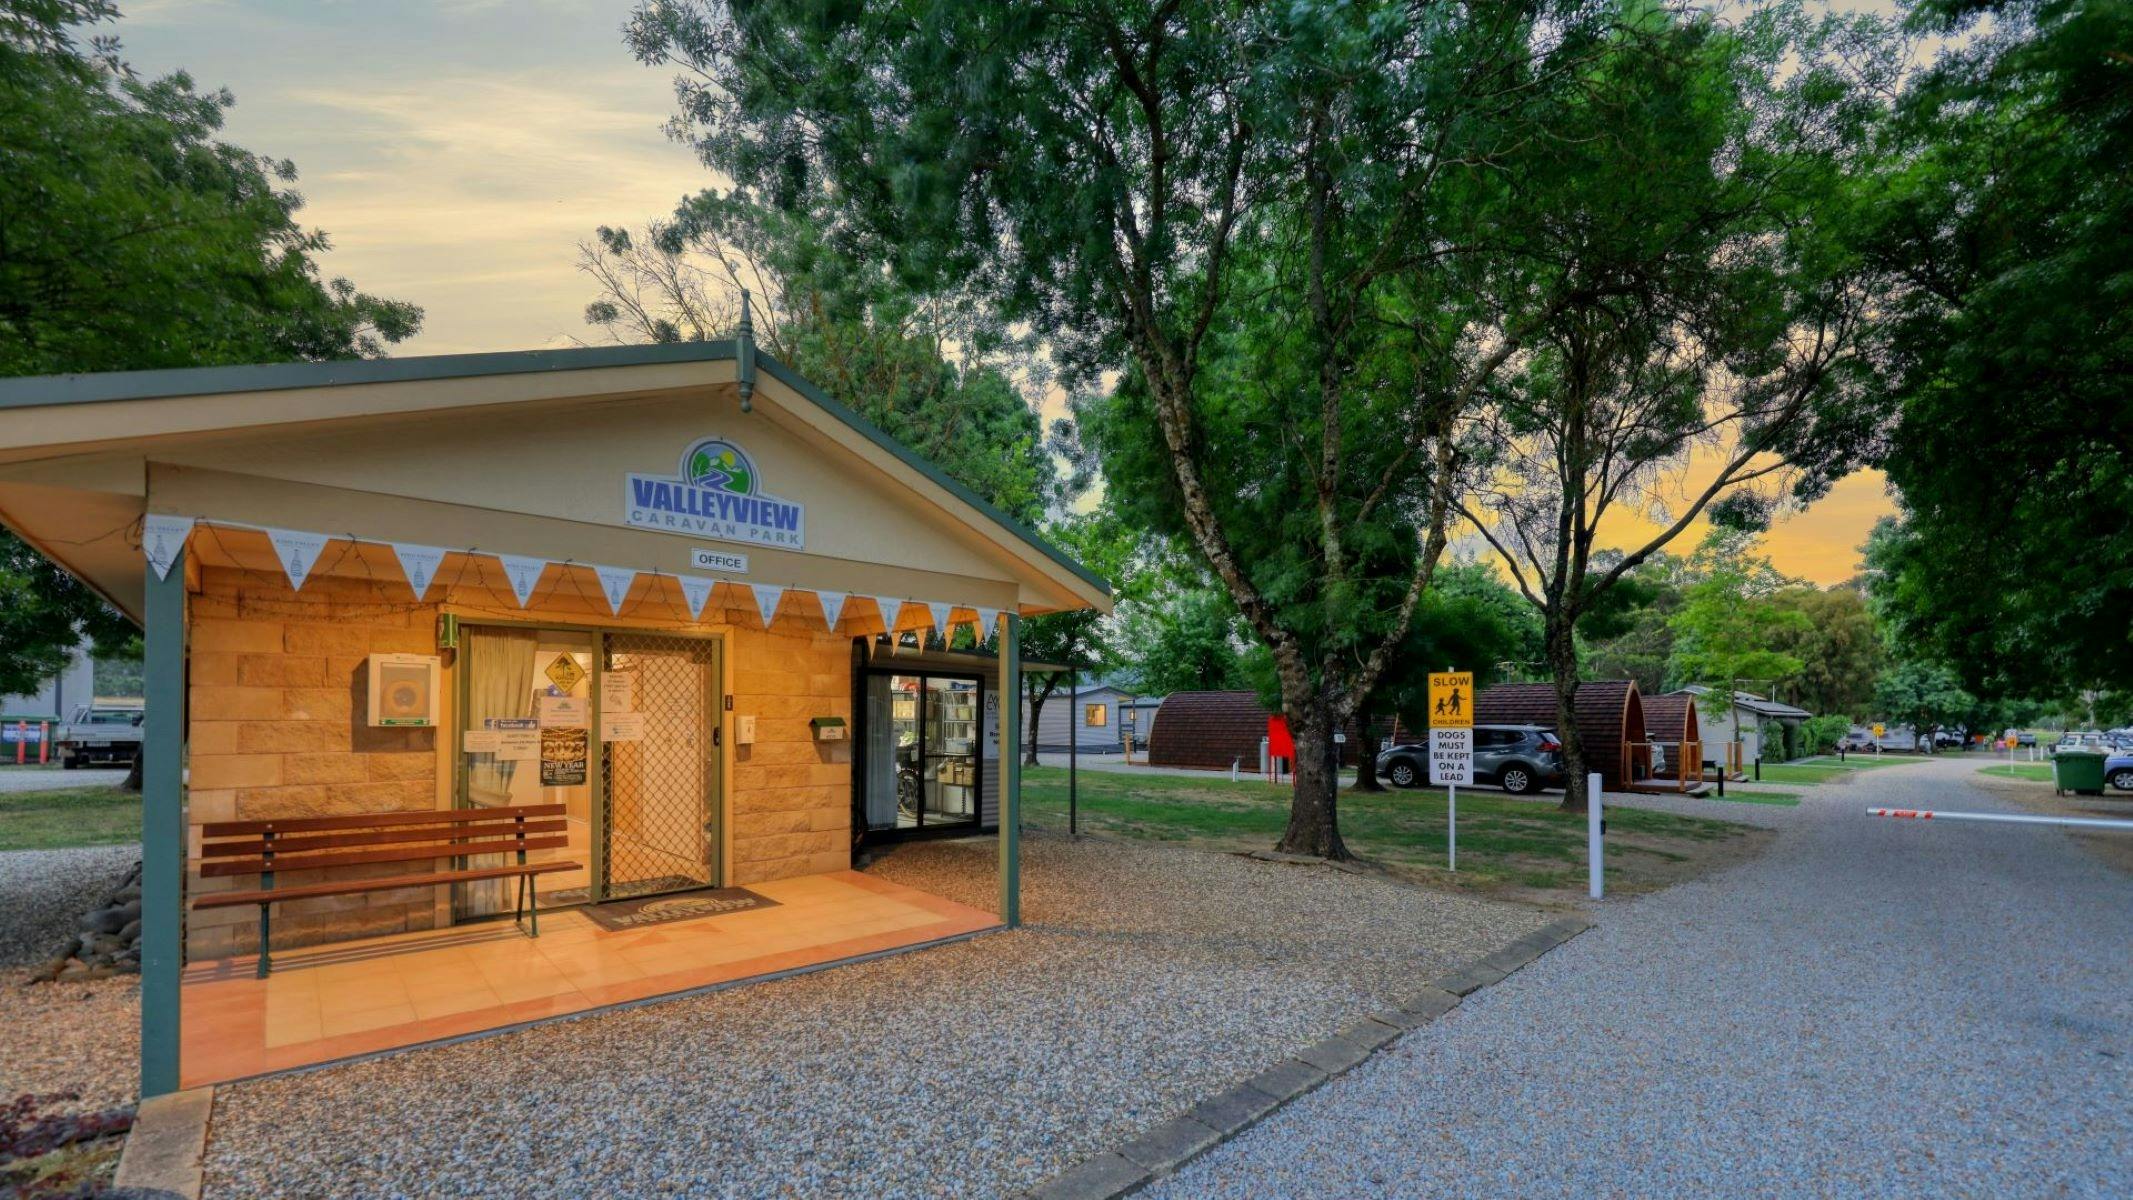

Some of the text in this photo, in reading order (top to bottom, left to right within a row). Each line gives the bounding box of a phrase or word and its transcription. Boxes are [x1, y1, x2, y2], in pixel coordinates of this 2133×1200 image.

[632, 477, 799, 531] VALLEYVIEW
[631, 510, 799, 545] CARAVAN PARK
[698, 553, 742, 569] OFFICE
[1433, 677, 1470, 686] SLOW
[1437, 731, 1466, 740] DOGS
[1438, 741, 1465, 750] MUST
[1433, 751, 1470, 760] BE KEPT
[1438, 762, 1465, 771] ON A
[1440, 773, 1464, 781] LEAD
